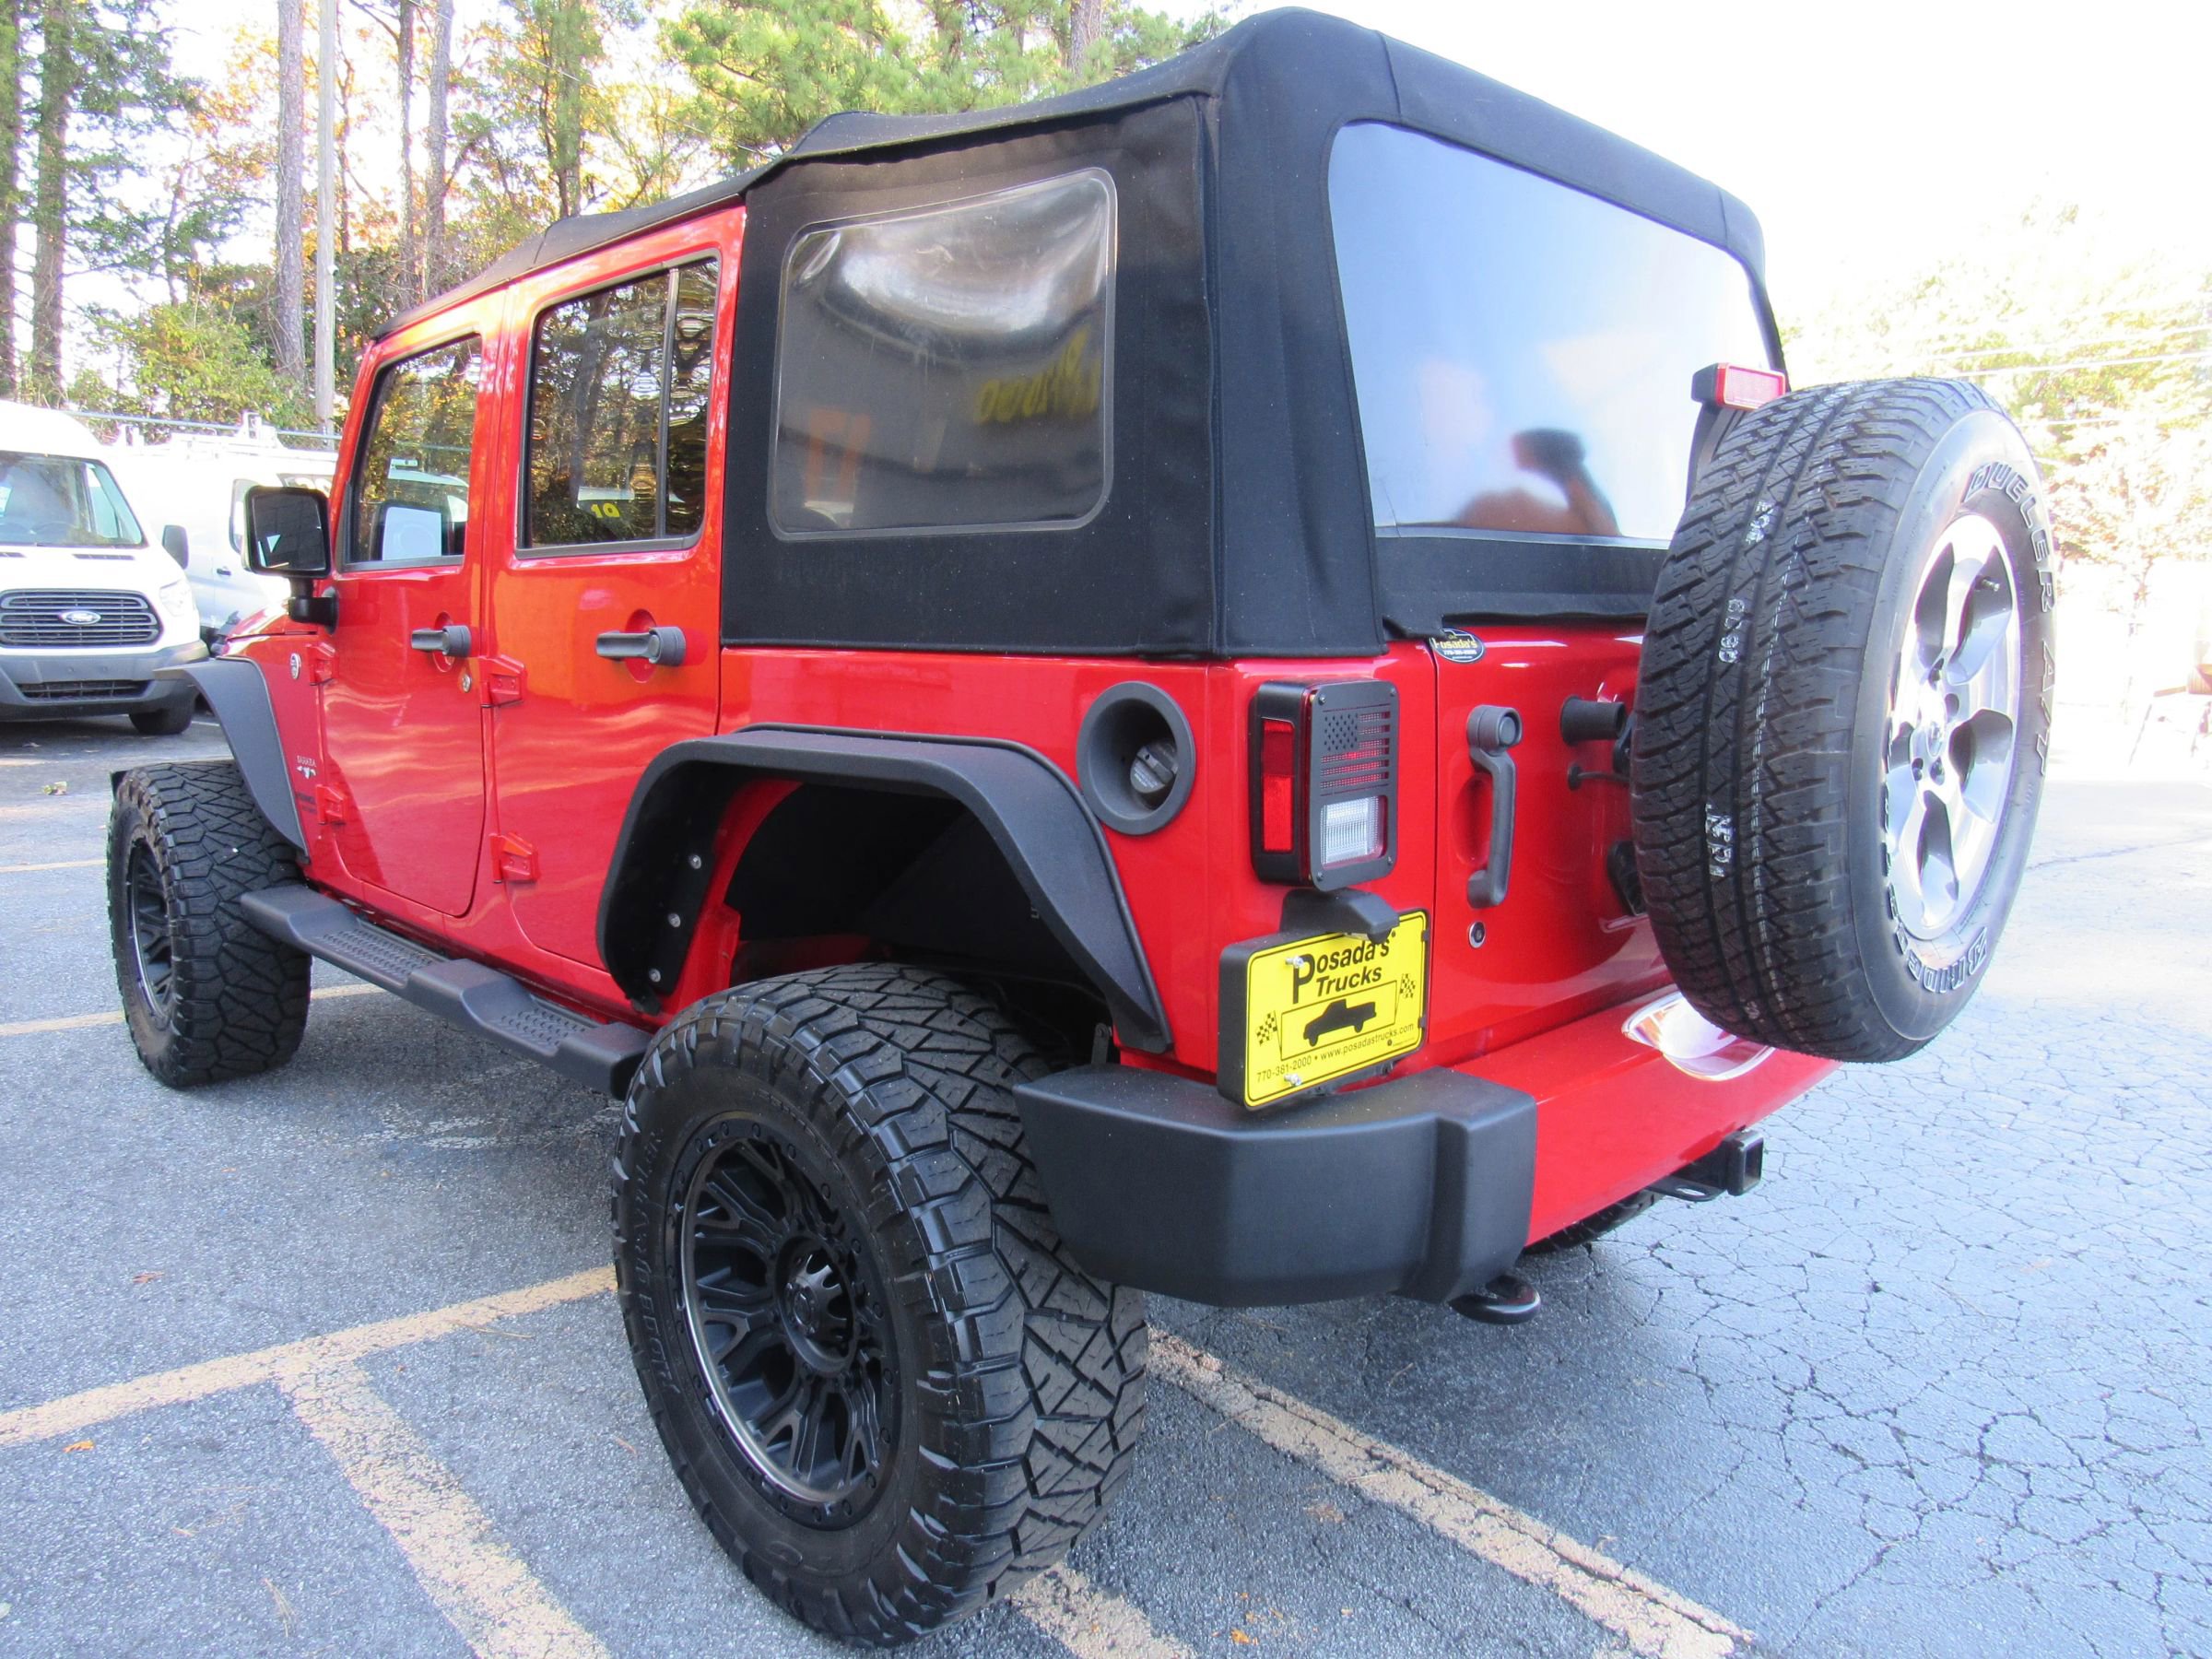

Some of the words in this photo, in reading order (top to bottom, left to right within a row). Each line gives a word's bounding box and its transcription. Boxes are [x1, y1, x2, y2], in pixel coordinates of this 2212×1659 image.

[1961, 461, 2055, 612] DUELER
[1293, 939, 1390, 1005] Posadas
[1316, 966, 1382, 997] Trucks
[1257, 1055, 1312, 1083] 770-381-2000
[1321, 1023, 1414, 1061] www.posadastrucks.com
